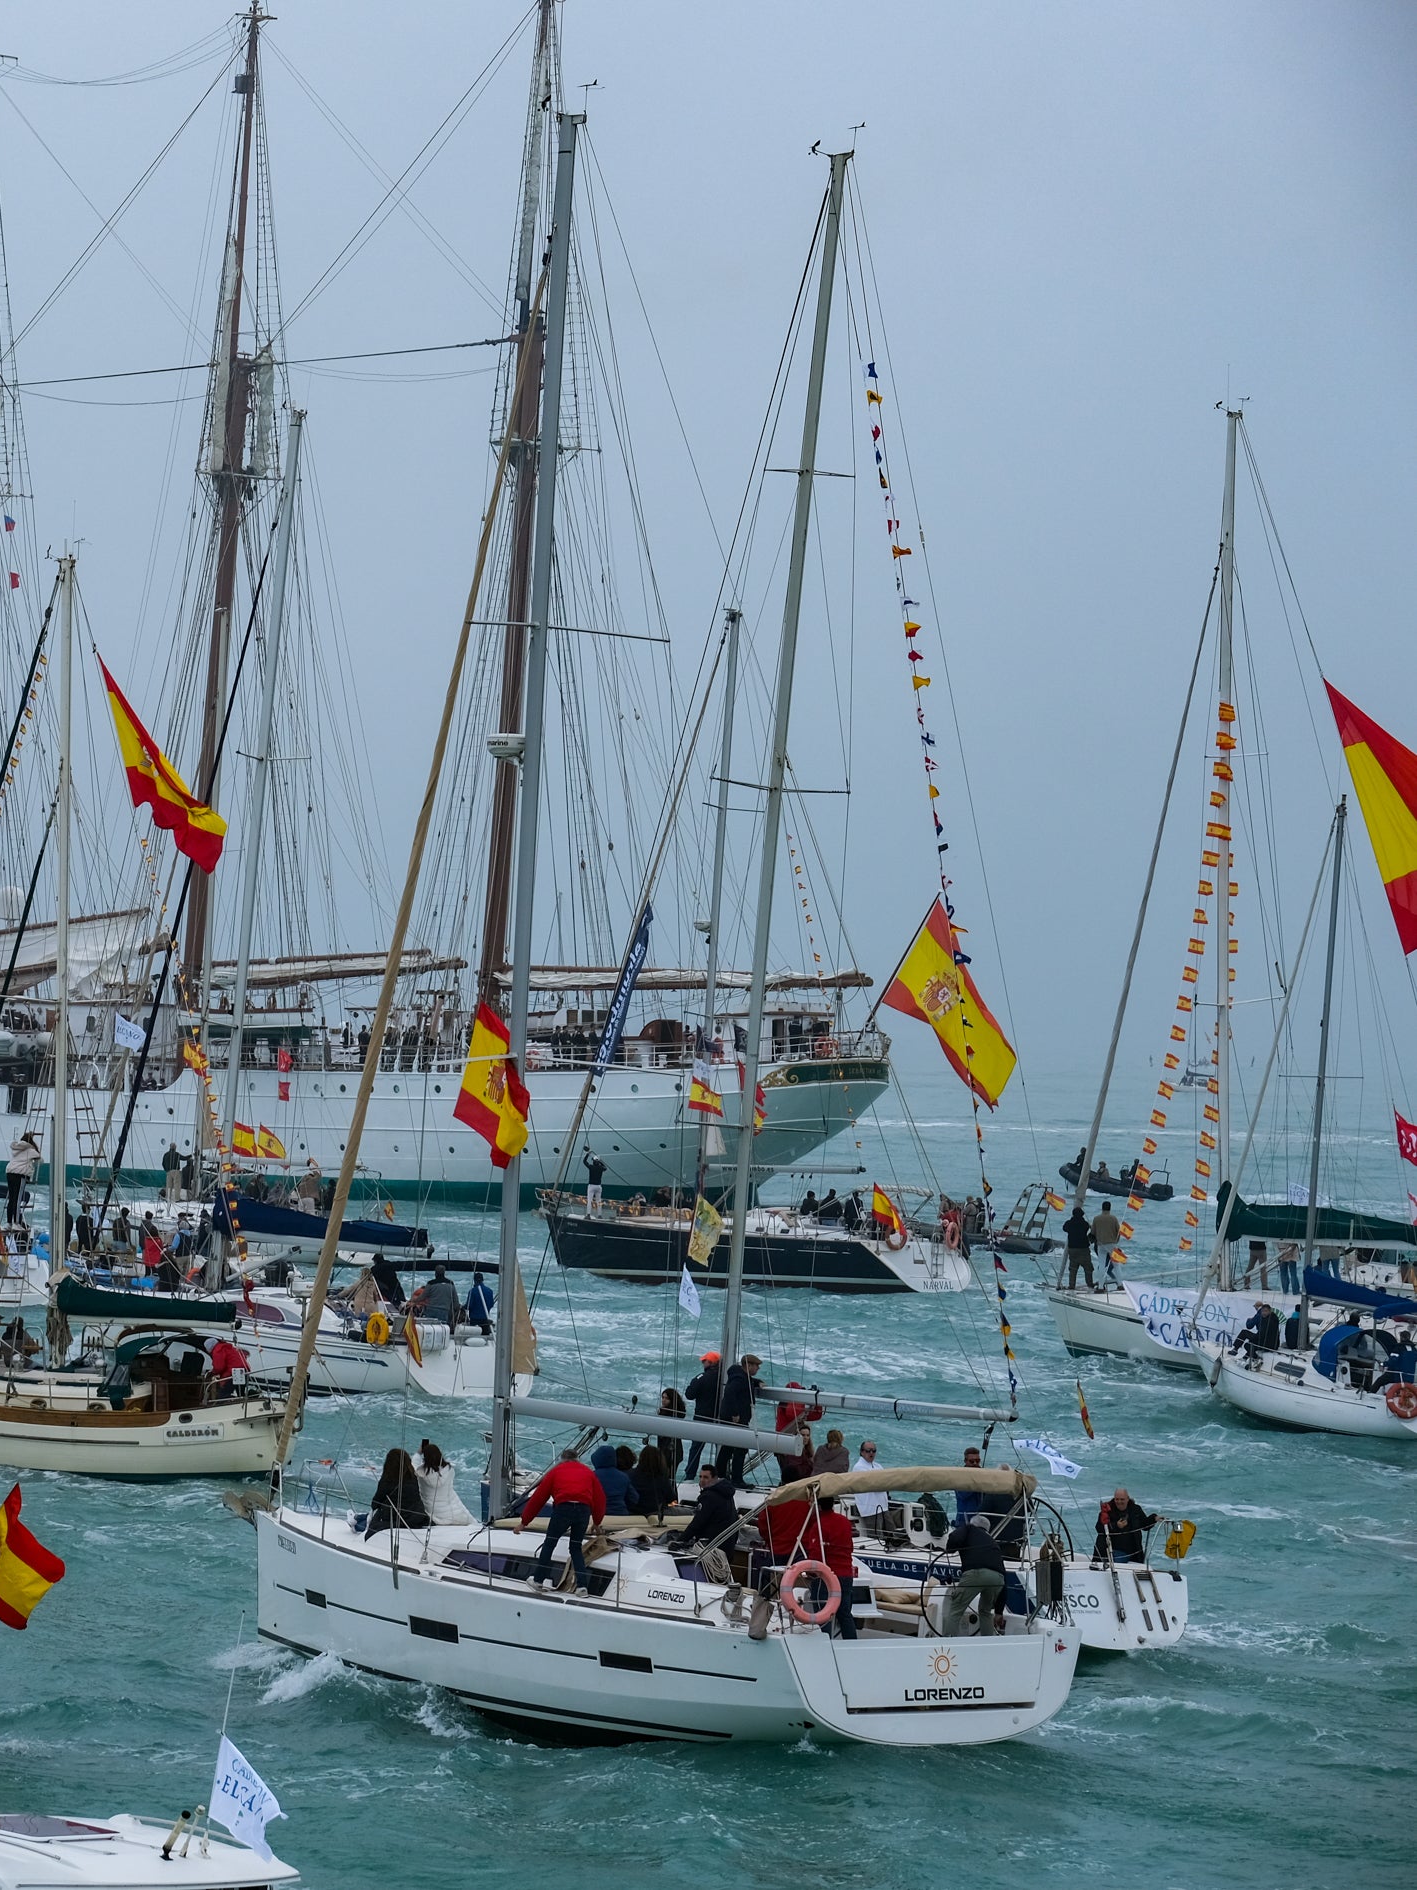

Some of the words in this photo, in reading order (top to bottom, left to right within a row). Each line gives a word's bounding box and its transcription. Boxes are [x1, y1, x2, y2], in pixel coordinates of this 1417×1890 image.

[923, 1280, 954, 1290] NARVAL
[1192, 1302, 1231, 1324] CON
[166, 1426, 219, 1438] CALDERÓN
[903, 1563, 918, 1573] DE
[647, 1589, 686, 1604] LORENZO
[904, 1686, 985, 1702] LORENZO
